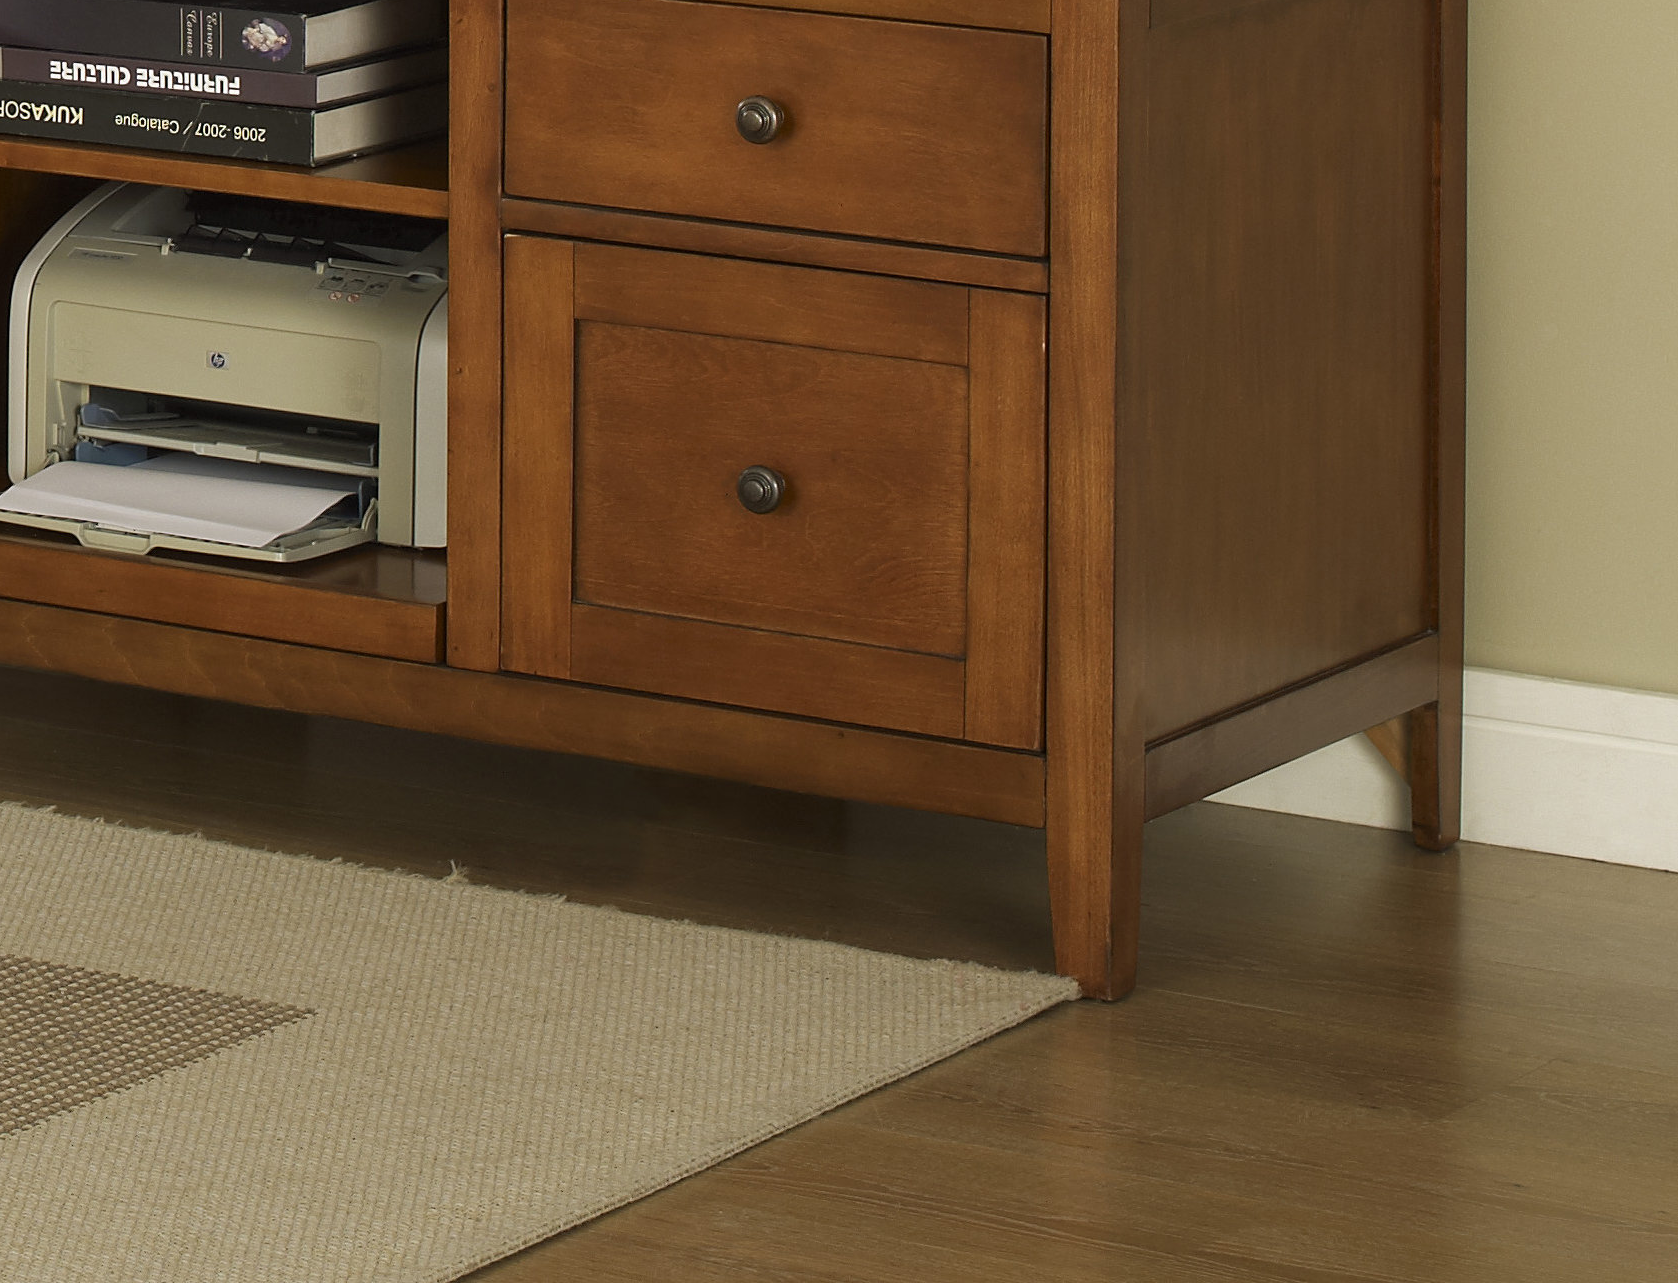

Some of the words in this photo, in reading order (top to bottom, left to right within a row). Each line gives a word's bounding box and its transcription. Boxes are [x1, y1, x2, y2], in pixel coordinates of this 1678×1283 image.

[204, 12, 217, 57] Europe
[50, 60, 131, 85] CULTURE
[115, 114, 180, 134] Catalogue
[195, 123, 266, 142] 2006-2007
